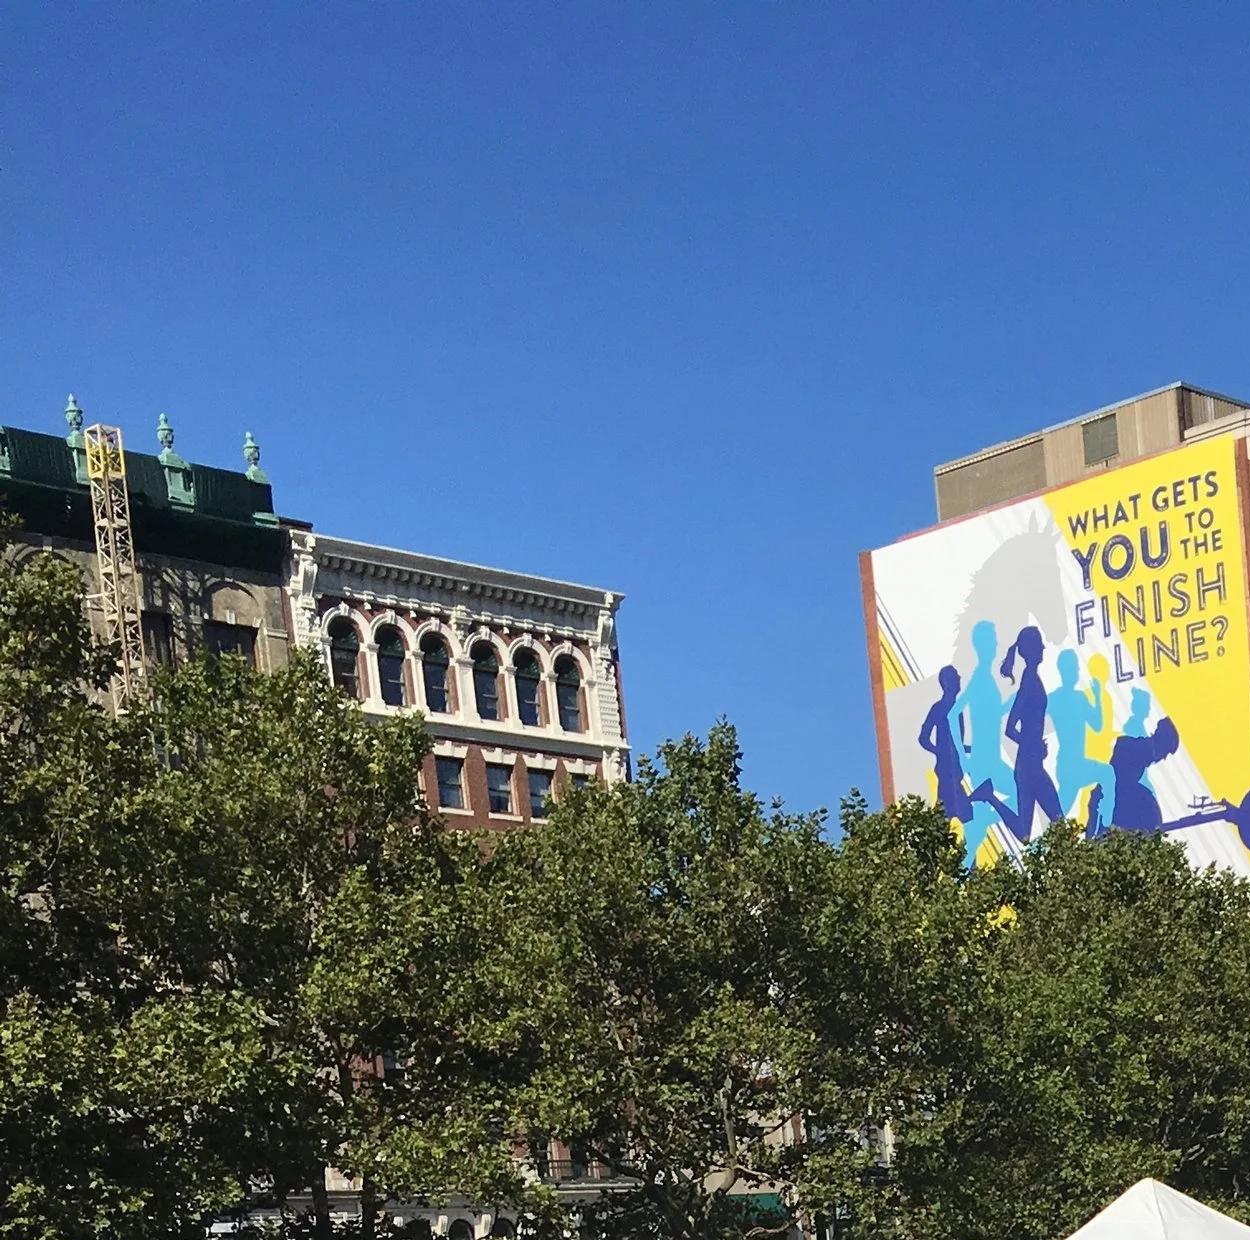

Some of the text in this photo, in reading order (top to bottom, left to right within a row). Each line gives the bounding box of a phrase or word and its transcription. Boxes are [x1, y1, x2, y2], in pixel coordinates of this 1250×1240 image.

[1068, 470, 1219, 540] WHAT GETS
[1184, 507, 1214, 533] TO
[1071, 520, 1172, 591] YOU
[1180, 529, 1223, 559] THE
[1075, 562, 1227, 645] FINISH
[1113, 615, 1229, 683] LINE?
